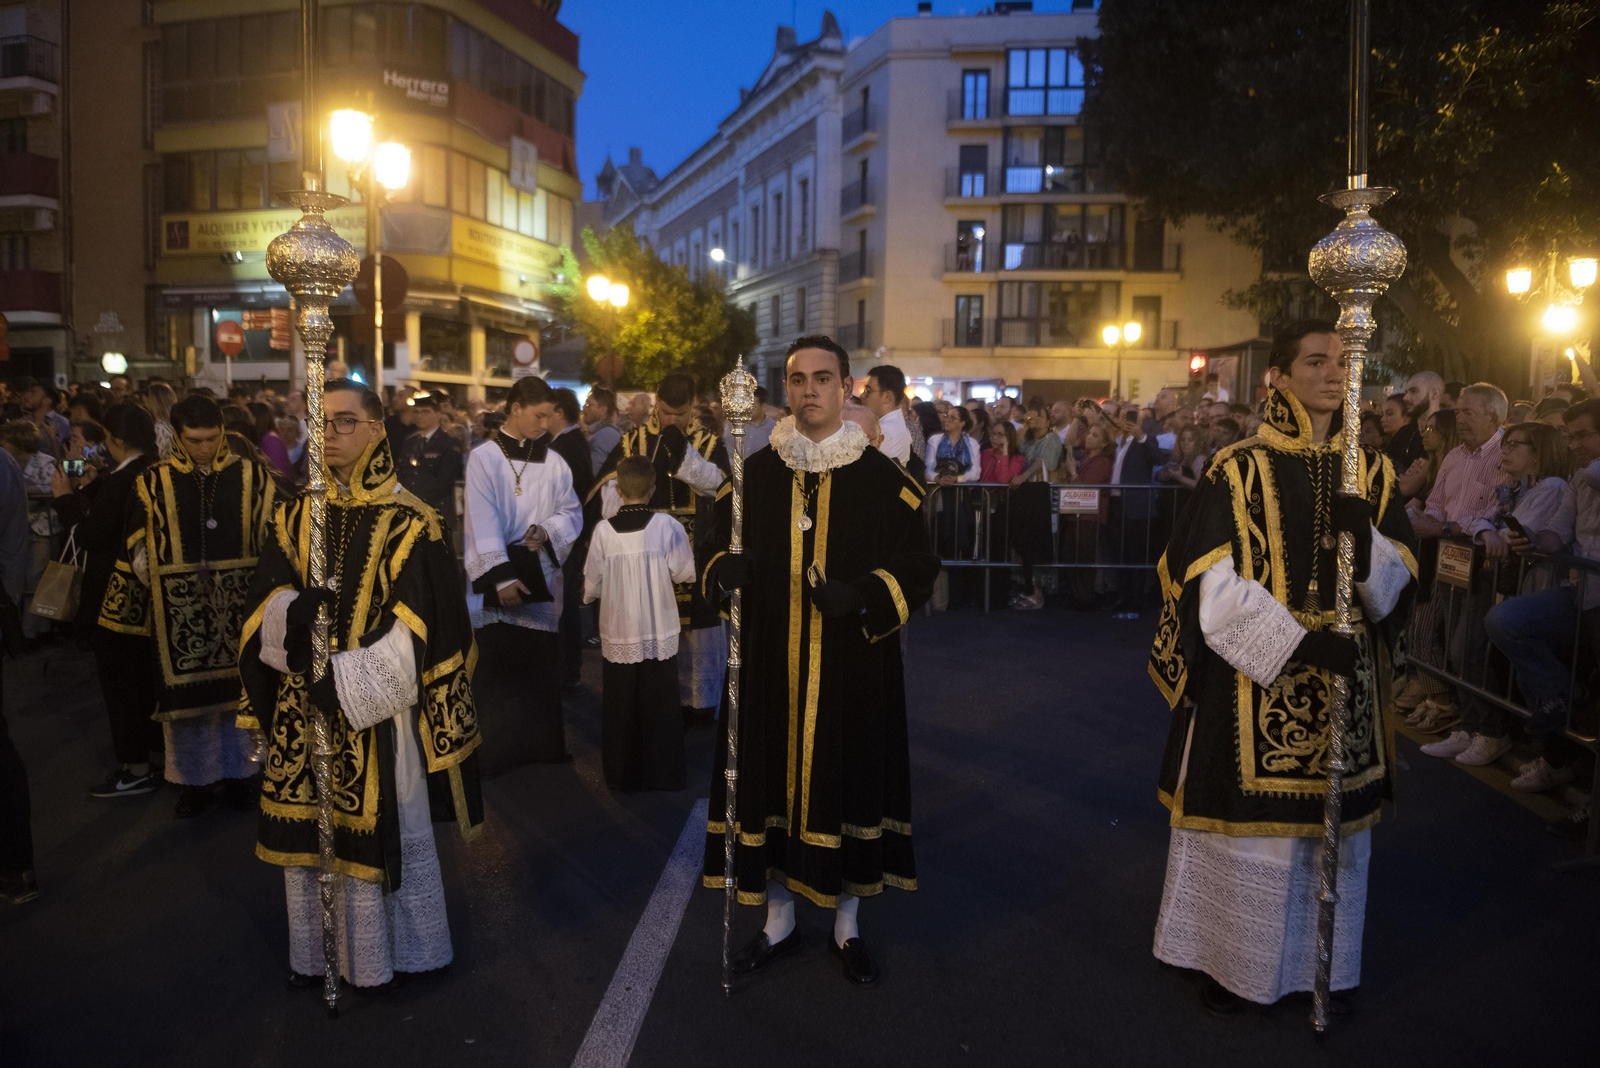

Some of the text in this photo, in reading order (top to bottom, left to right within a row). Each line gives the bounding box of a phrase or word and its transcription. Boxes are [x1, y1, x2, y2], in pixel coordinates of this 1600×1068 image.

[383, 70, 448, 95] Herrera
[197, 220, 250, 236] ALQUILER
[251, 220, 259, 233] Y
